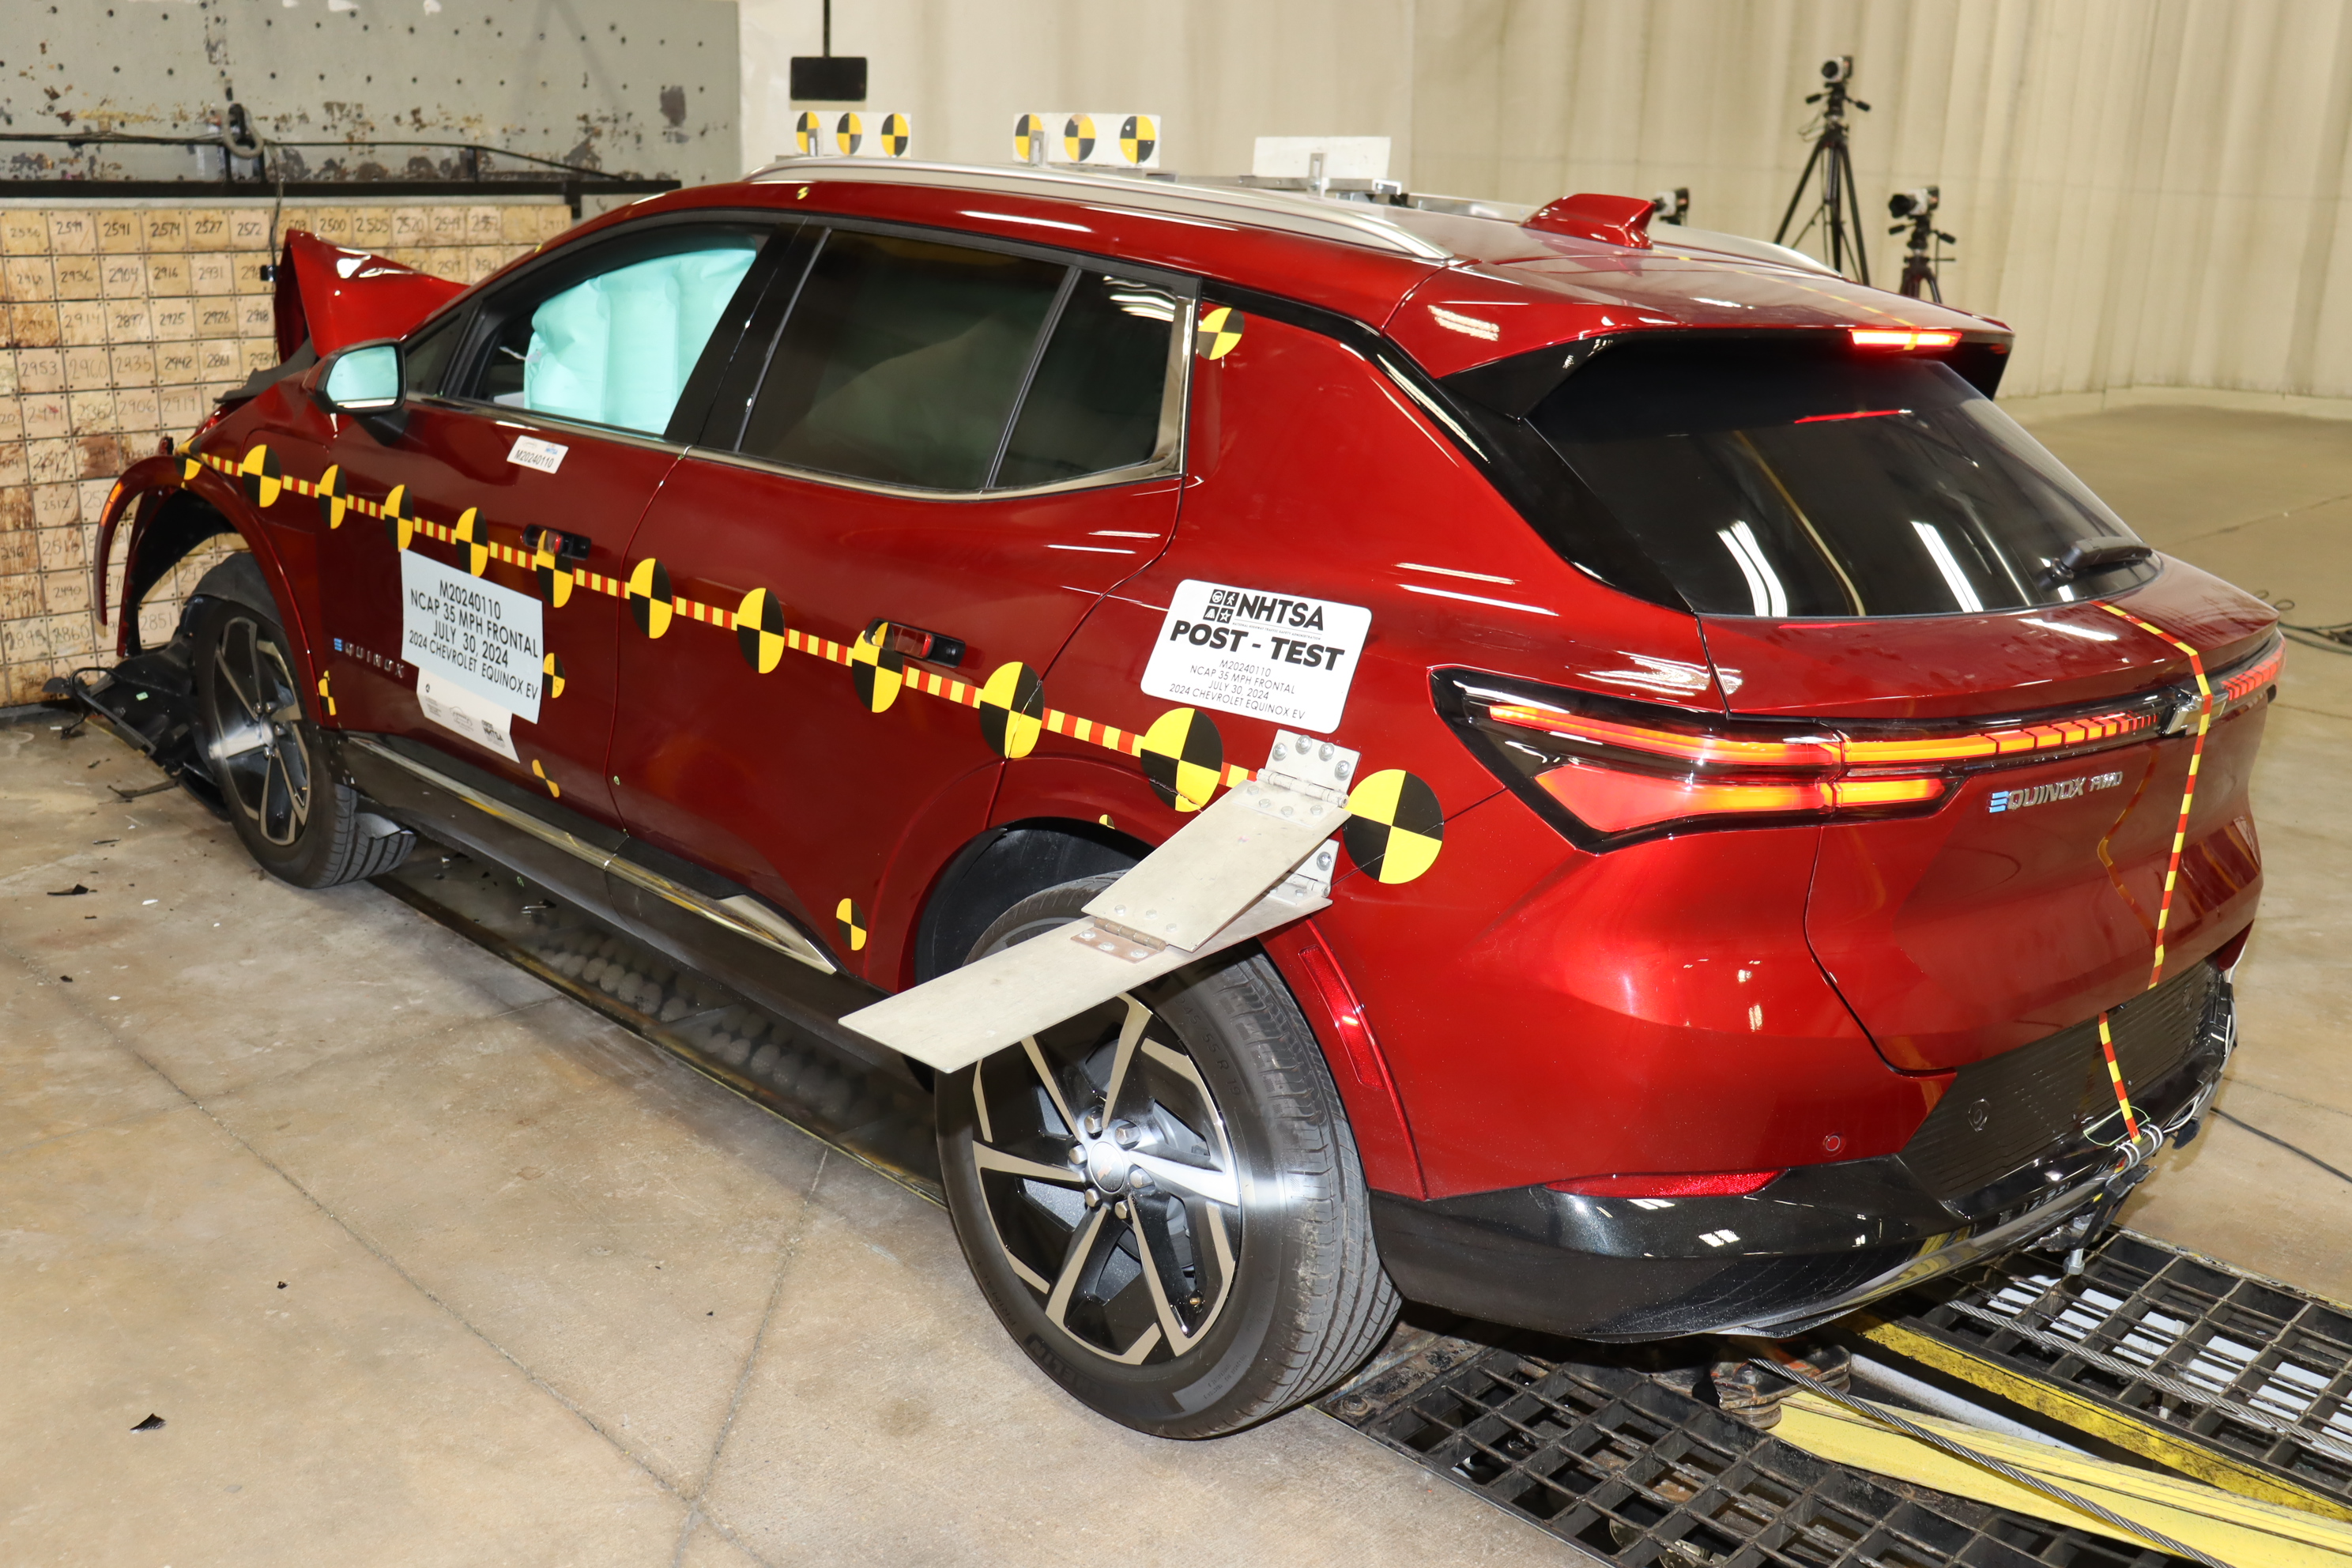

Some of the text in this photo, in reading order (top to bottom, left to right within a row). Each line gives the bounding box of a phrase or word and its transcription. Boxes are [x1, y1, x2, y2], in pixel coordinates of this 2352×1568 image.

[104, 222, 130, 237] 2591
[514, 450, 554, 468] M20240110
[439, 579, 501, 620] M20240110
[1236, 593, 1323, 631] NHTSA
[410, 588, 538, 658] NCAP 35 MPH FRONTAL
[334, 638, 404, 678] EQUINOX
[433, 620, 508, 668] JULY 30, 2024
[1170, 620, 1249, 652] POST
[1271, 636, 1345, 671] TEST
[409, 630, 538, 699] 2024 CHEVROLET EQUINOX EV
[1190, 665, 1295, 695] NCAP 35 MPH FRONTAL
[1219, 659, 1271, 677] M20240110
[1169, 683, 1306, 720] 2024 CHEVROLET EQUINOX EV
[1208, 680, 1269, 699] JULY 30, 2024
[1988, 771, 2124, 813] EQUINOX AWD
